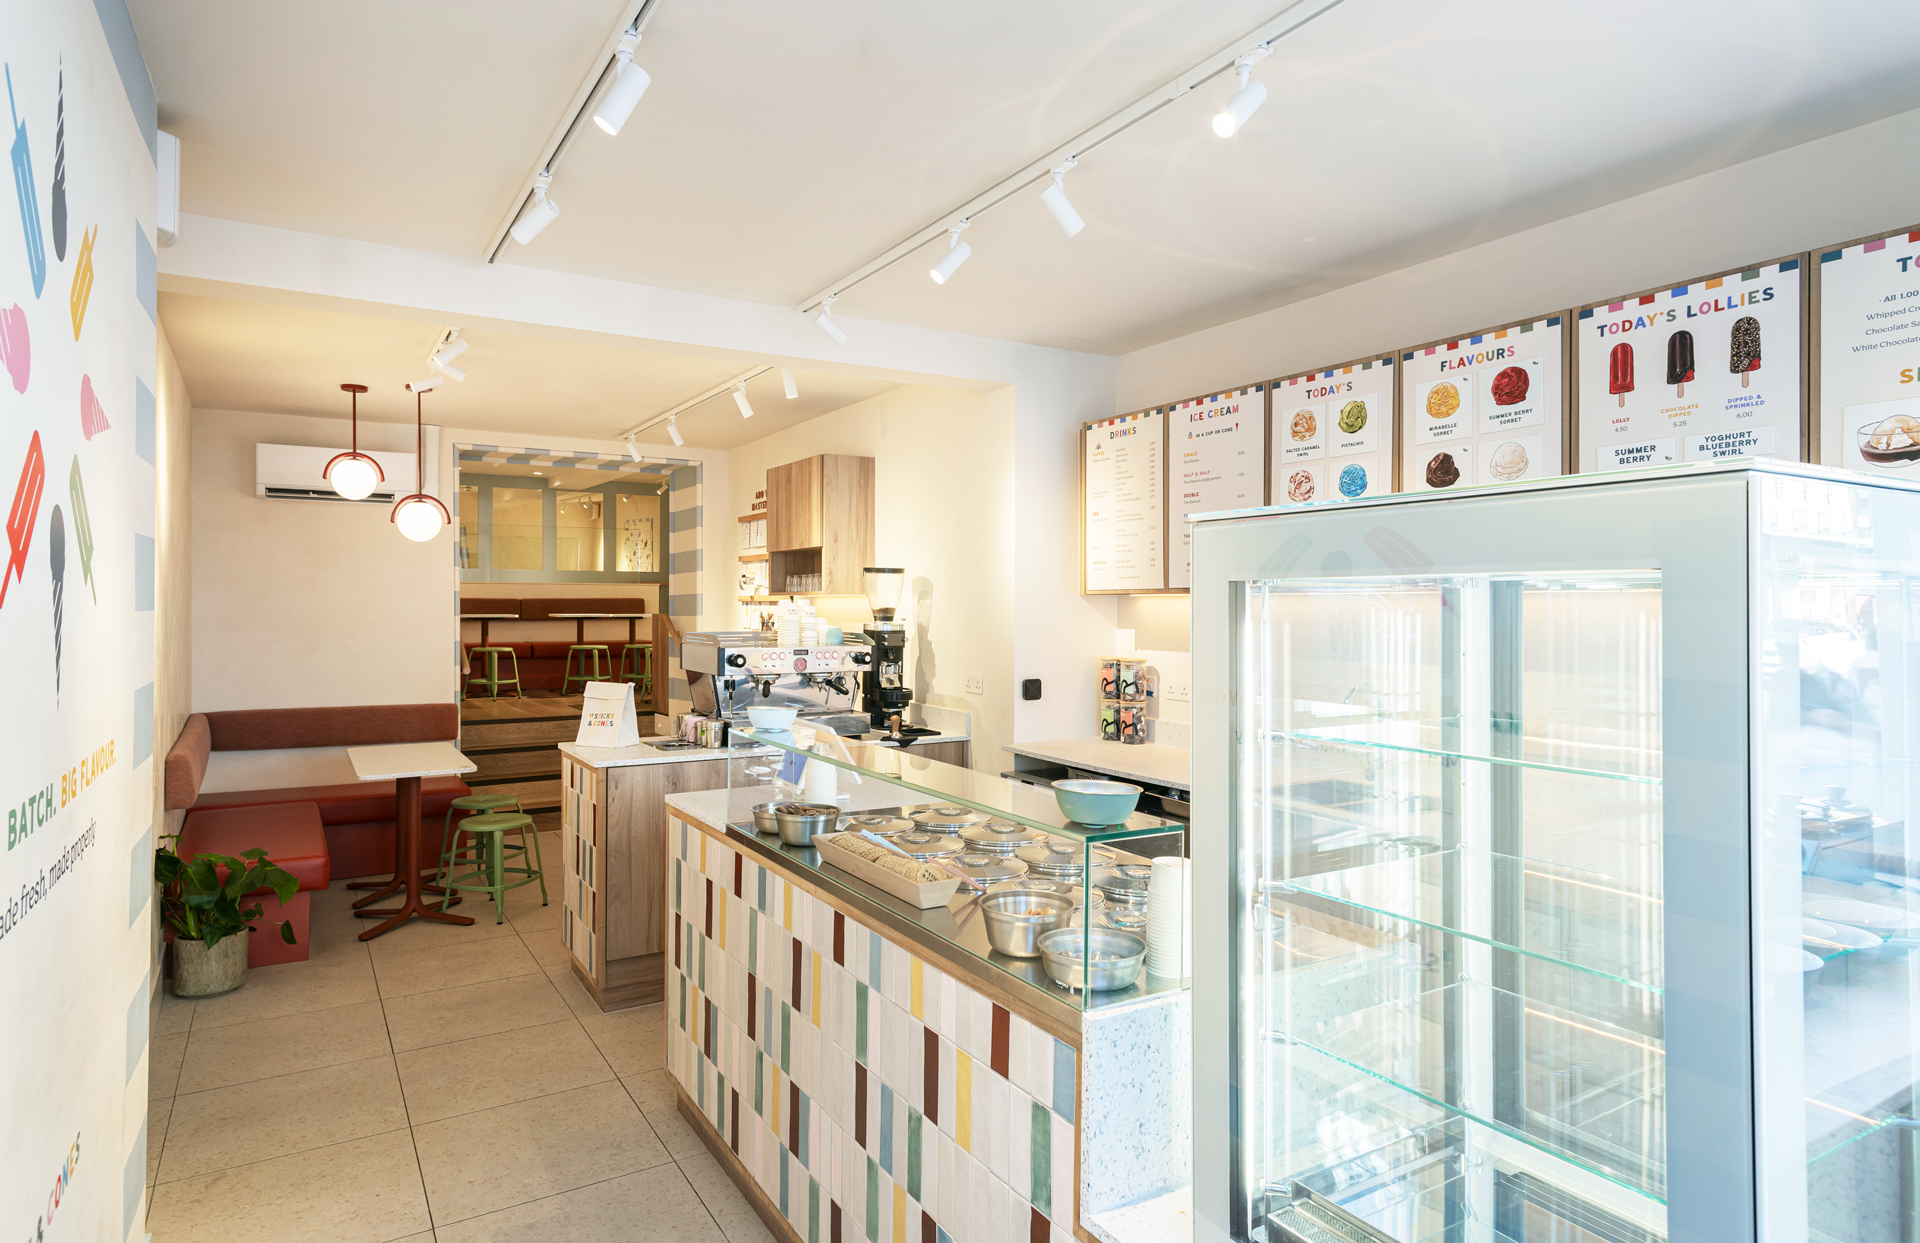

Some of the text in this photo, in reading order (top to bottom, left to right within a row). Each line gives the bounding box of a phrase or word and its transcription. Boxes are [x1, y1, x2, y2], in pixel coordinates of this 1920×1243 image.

[1884, 290, 1918, 302] All 1.00
[1596, 286, 1774, 337] TODAY'S LOLLIES
[1866, 307, 1906, 321] Whipped
[1866, 323, 1910, 336] Chocolate
[1852, 343, 1878, 352] White
[1440, 346, 1515, 372] FLAVOURS
[1306, 382, 1352, 400] TODAY'S
[1724, 399, 1765, 410] SPRINKLED
[1727, 396, 1754, 404] DIPPED
[1190, 404, 1239, 422] ICE CREAM
[1488, 408, 1533, 420] SUMMER BERRY
[1660, 403, 1700, 414] CHOCOLATE
[1668, 410, 1692, 419] DIPPED
[1500, 417, 1522, 425] SORBET
[1736, 411, 1753, 419] 6.00
[1110, 427, 1136, 439] DRINKS
[1429, 422, 1458, 432] MIRABELLE
[1704, 431, 1753, 443] YOGHURT
[1614, 444, 1656, 457] SUMMER
[1699, 438, 1758, 451] BLUEBERRY
[1712, 448, 1744, 458] SWIRL
[1619, 454, 1652, 465] BERRY
[8, 739, 117, 852] BATCH. BIG FLAVOUR.
[20, 868, 48, 920] fresh,
[48, 844, 70, 890] made
[70, 816, 97, 873] properly
[47, 1131, 80, 1227] CONES
